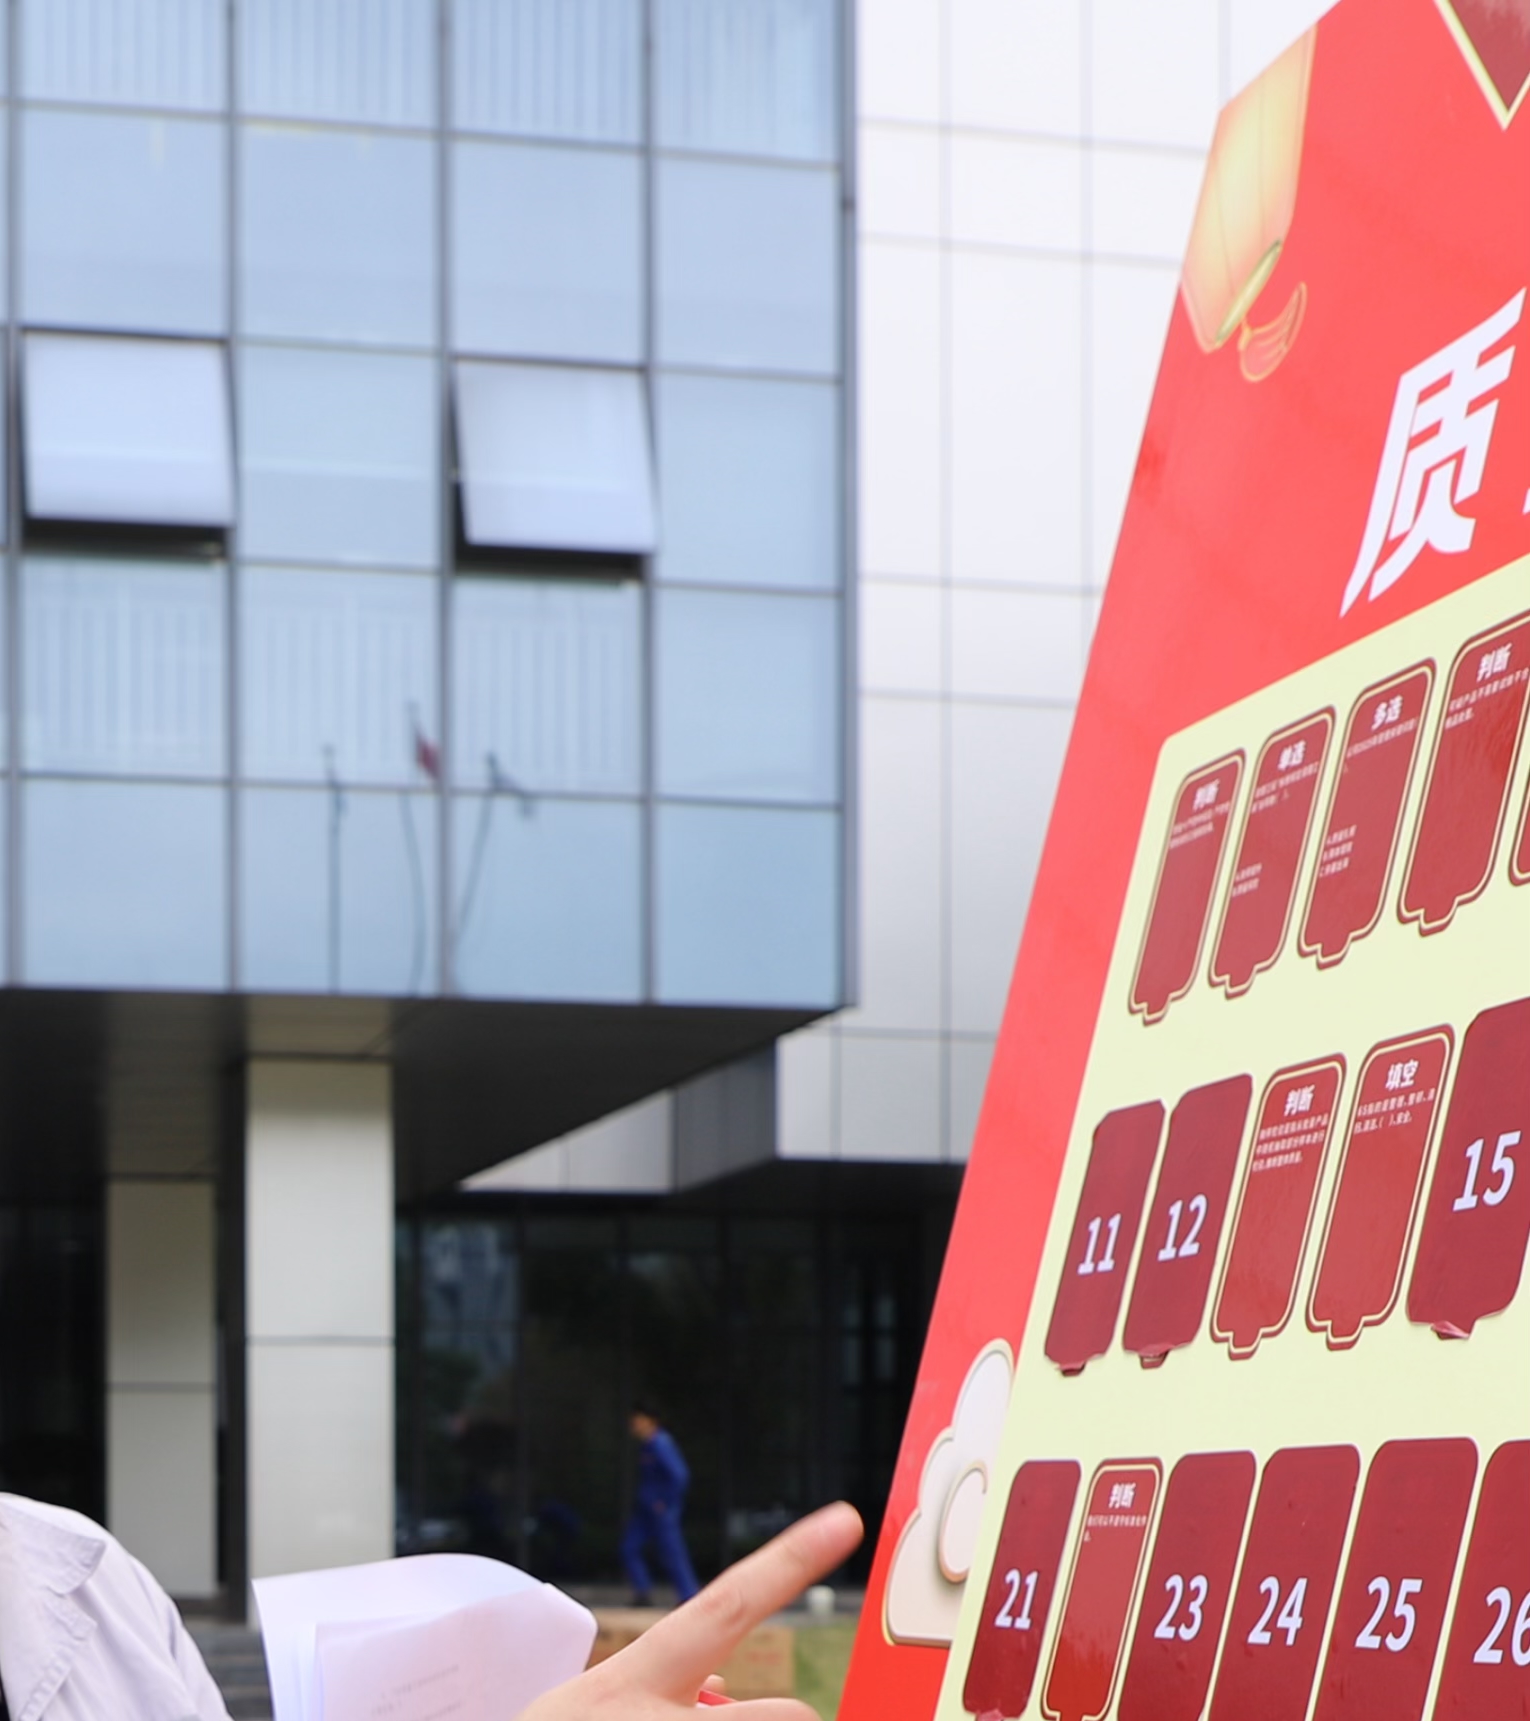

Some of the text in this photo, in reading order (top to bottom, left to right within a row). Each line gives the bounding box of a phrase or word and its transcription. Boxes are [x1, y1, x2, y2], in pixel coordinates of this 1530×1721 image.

[1340, 287, 1530, 616] 质
[1371, 694, 1403, 731] 多选
[1284, 1085, 1315, 1116] 判断
[1385, 1059, 1419, 1091] 填空
[1453, 1132, 1521, 1211] 15
[1078, 1215, 1121, 1275] 11
[1158, 1195, 1207, 1261] 12
[1108, 1482, 1136, 1508] 判断
[995, 1569, 1037, 1630] 21
[1154, 1575, 1208, 1640] 23
[1247, 1577, 1307, 1646] 24
[1355, 1577, 1422, 1652] 25
